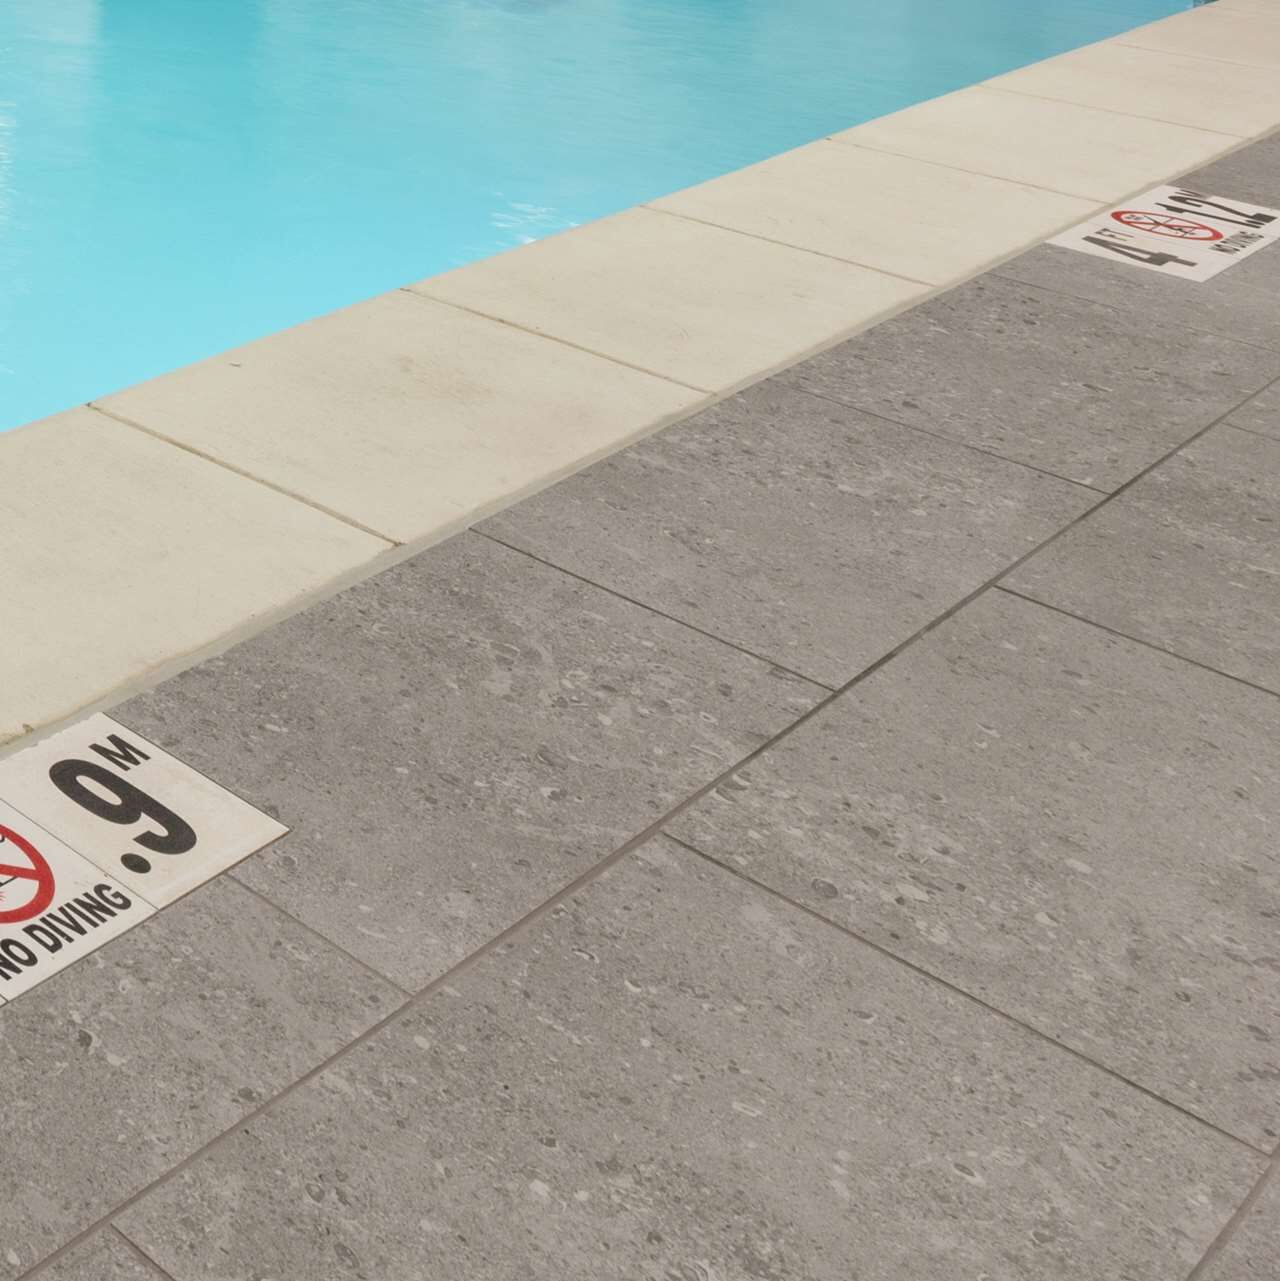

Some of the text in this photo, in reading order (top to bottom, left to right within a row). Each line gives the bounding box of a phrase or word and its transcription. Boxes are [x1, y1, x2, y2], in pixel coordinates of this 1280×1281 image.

[1081, 235, 1199, 267] 4
[88, 733, 152, 772] M
[37, 882, 134, 956] DIVING
